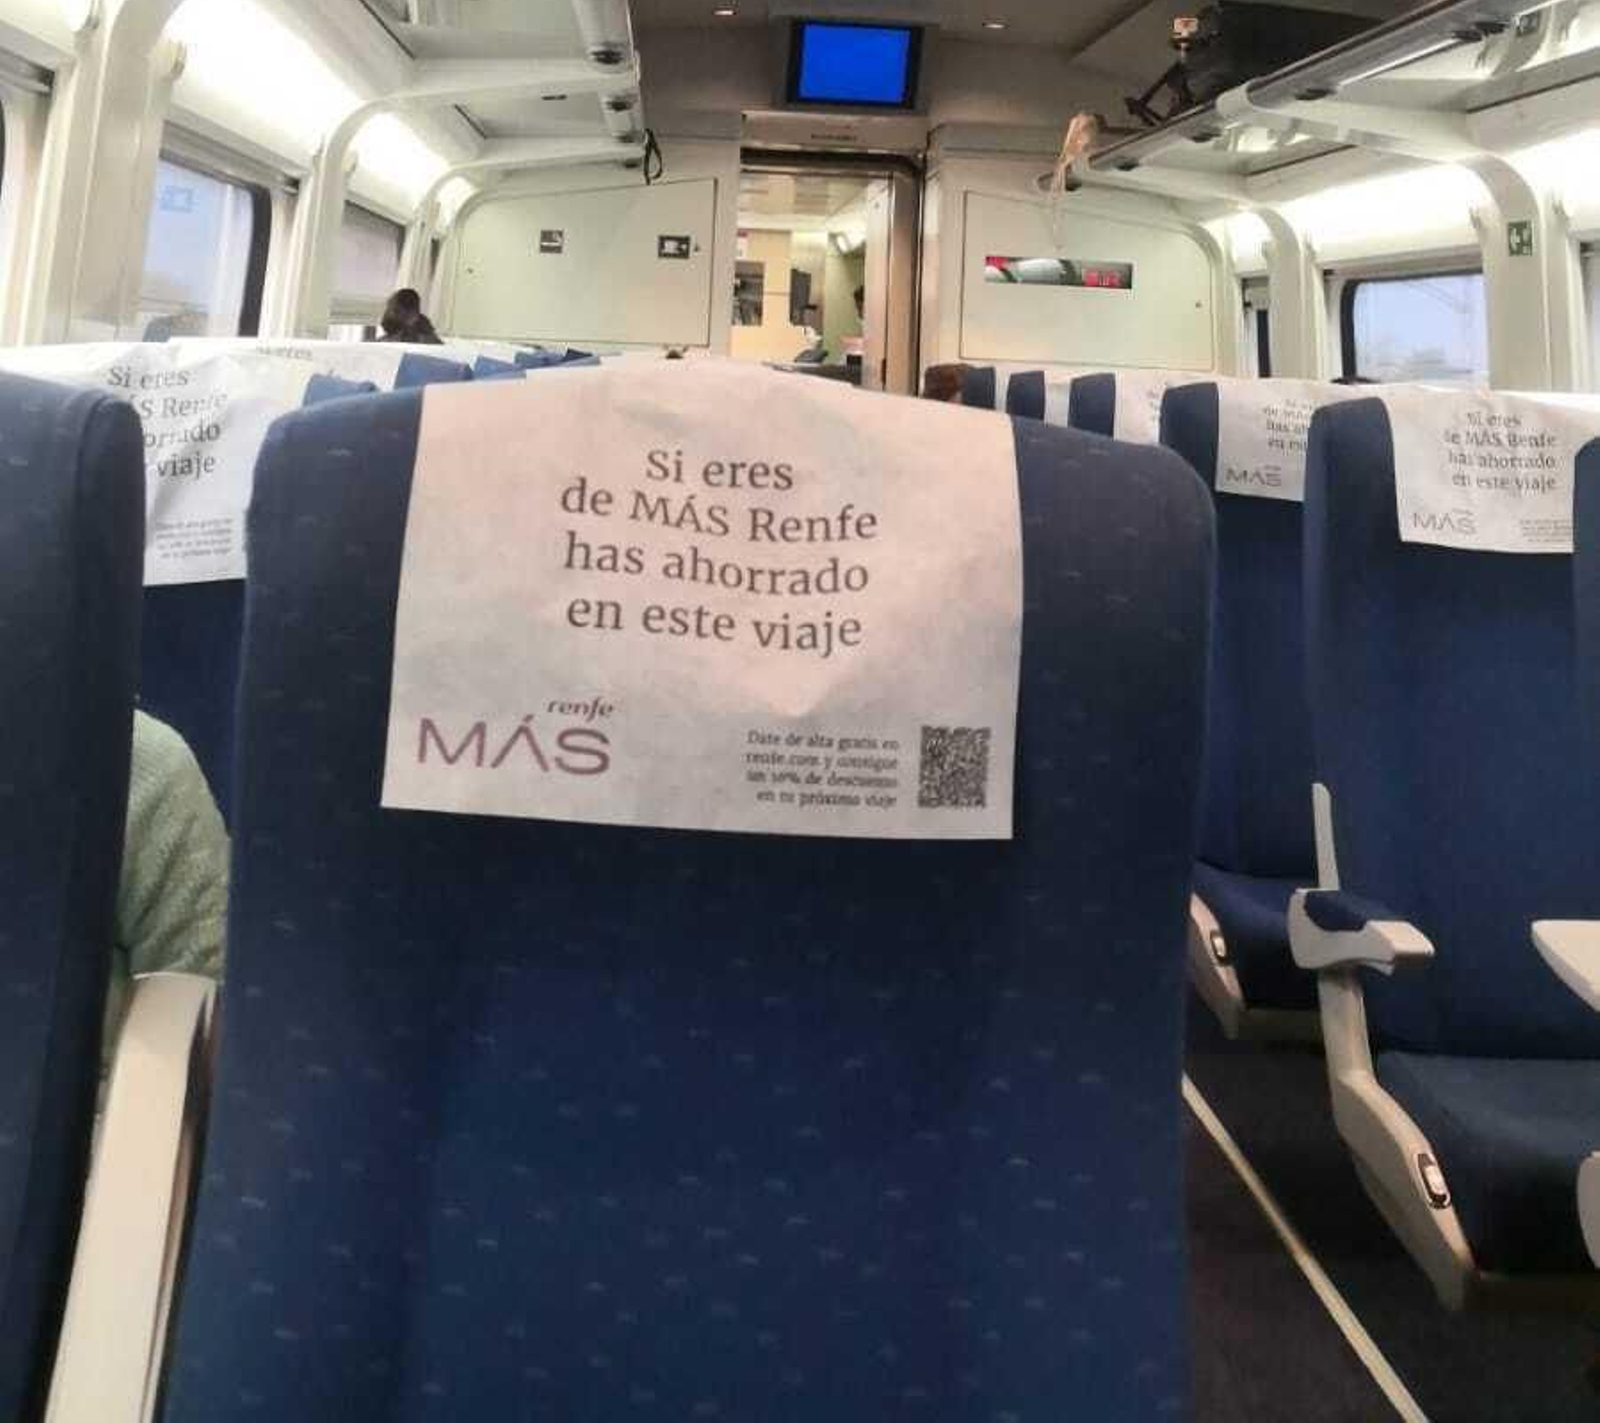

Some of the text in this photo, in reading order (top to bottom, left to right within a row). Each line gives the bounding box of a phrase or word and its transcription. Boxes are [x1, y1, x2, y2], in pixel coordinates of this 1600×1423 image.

[107, 366, 189, 389] Si eres
[157, 452, 215, 478] viaje
[646, 450, 794, 491] Si eres
[1479, 453, 1556, 469] ahorrado
[1476, 475, 1510, 491] este
[1515, 476, 1557, 494] viaje
[561, 477, 878, 543] de MÁS Renfe
[563, 530, 869, 596] has ahorrado
[566, 596, 862, 659] en este viaje
[547, 696, 614, 723] renfe
[417, 714, 610, 776] MÁS
[746, 729, 899, 752] Date de alta gratis en
[746, 751, 820, 766] renfe.com
[837, 756, 898, 772] consigue
[805, 770, 823, 784] de
[756, 791, 775, 802] en
[865, 794, 898, 809] viaje
